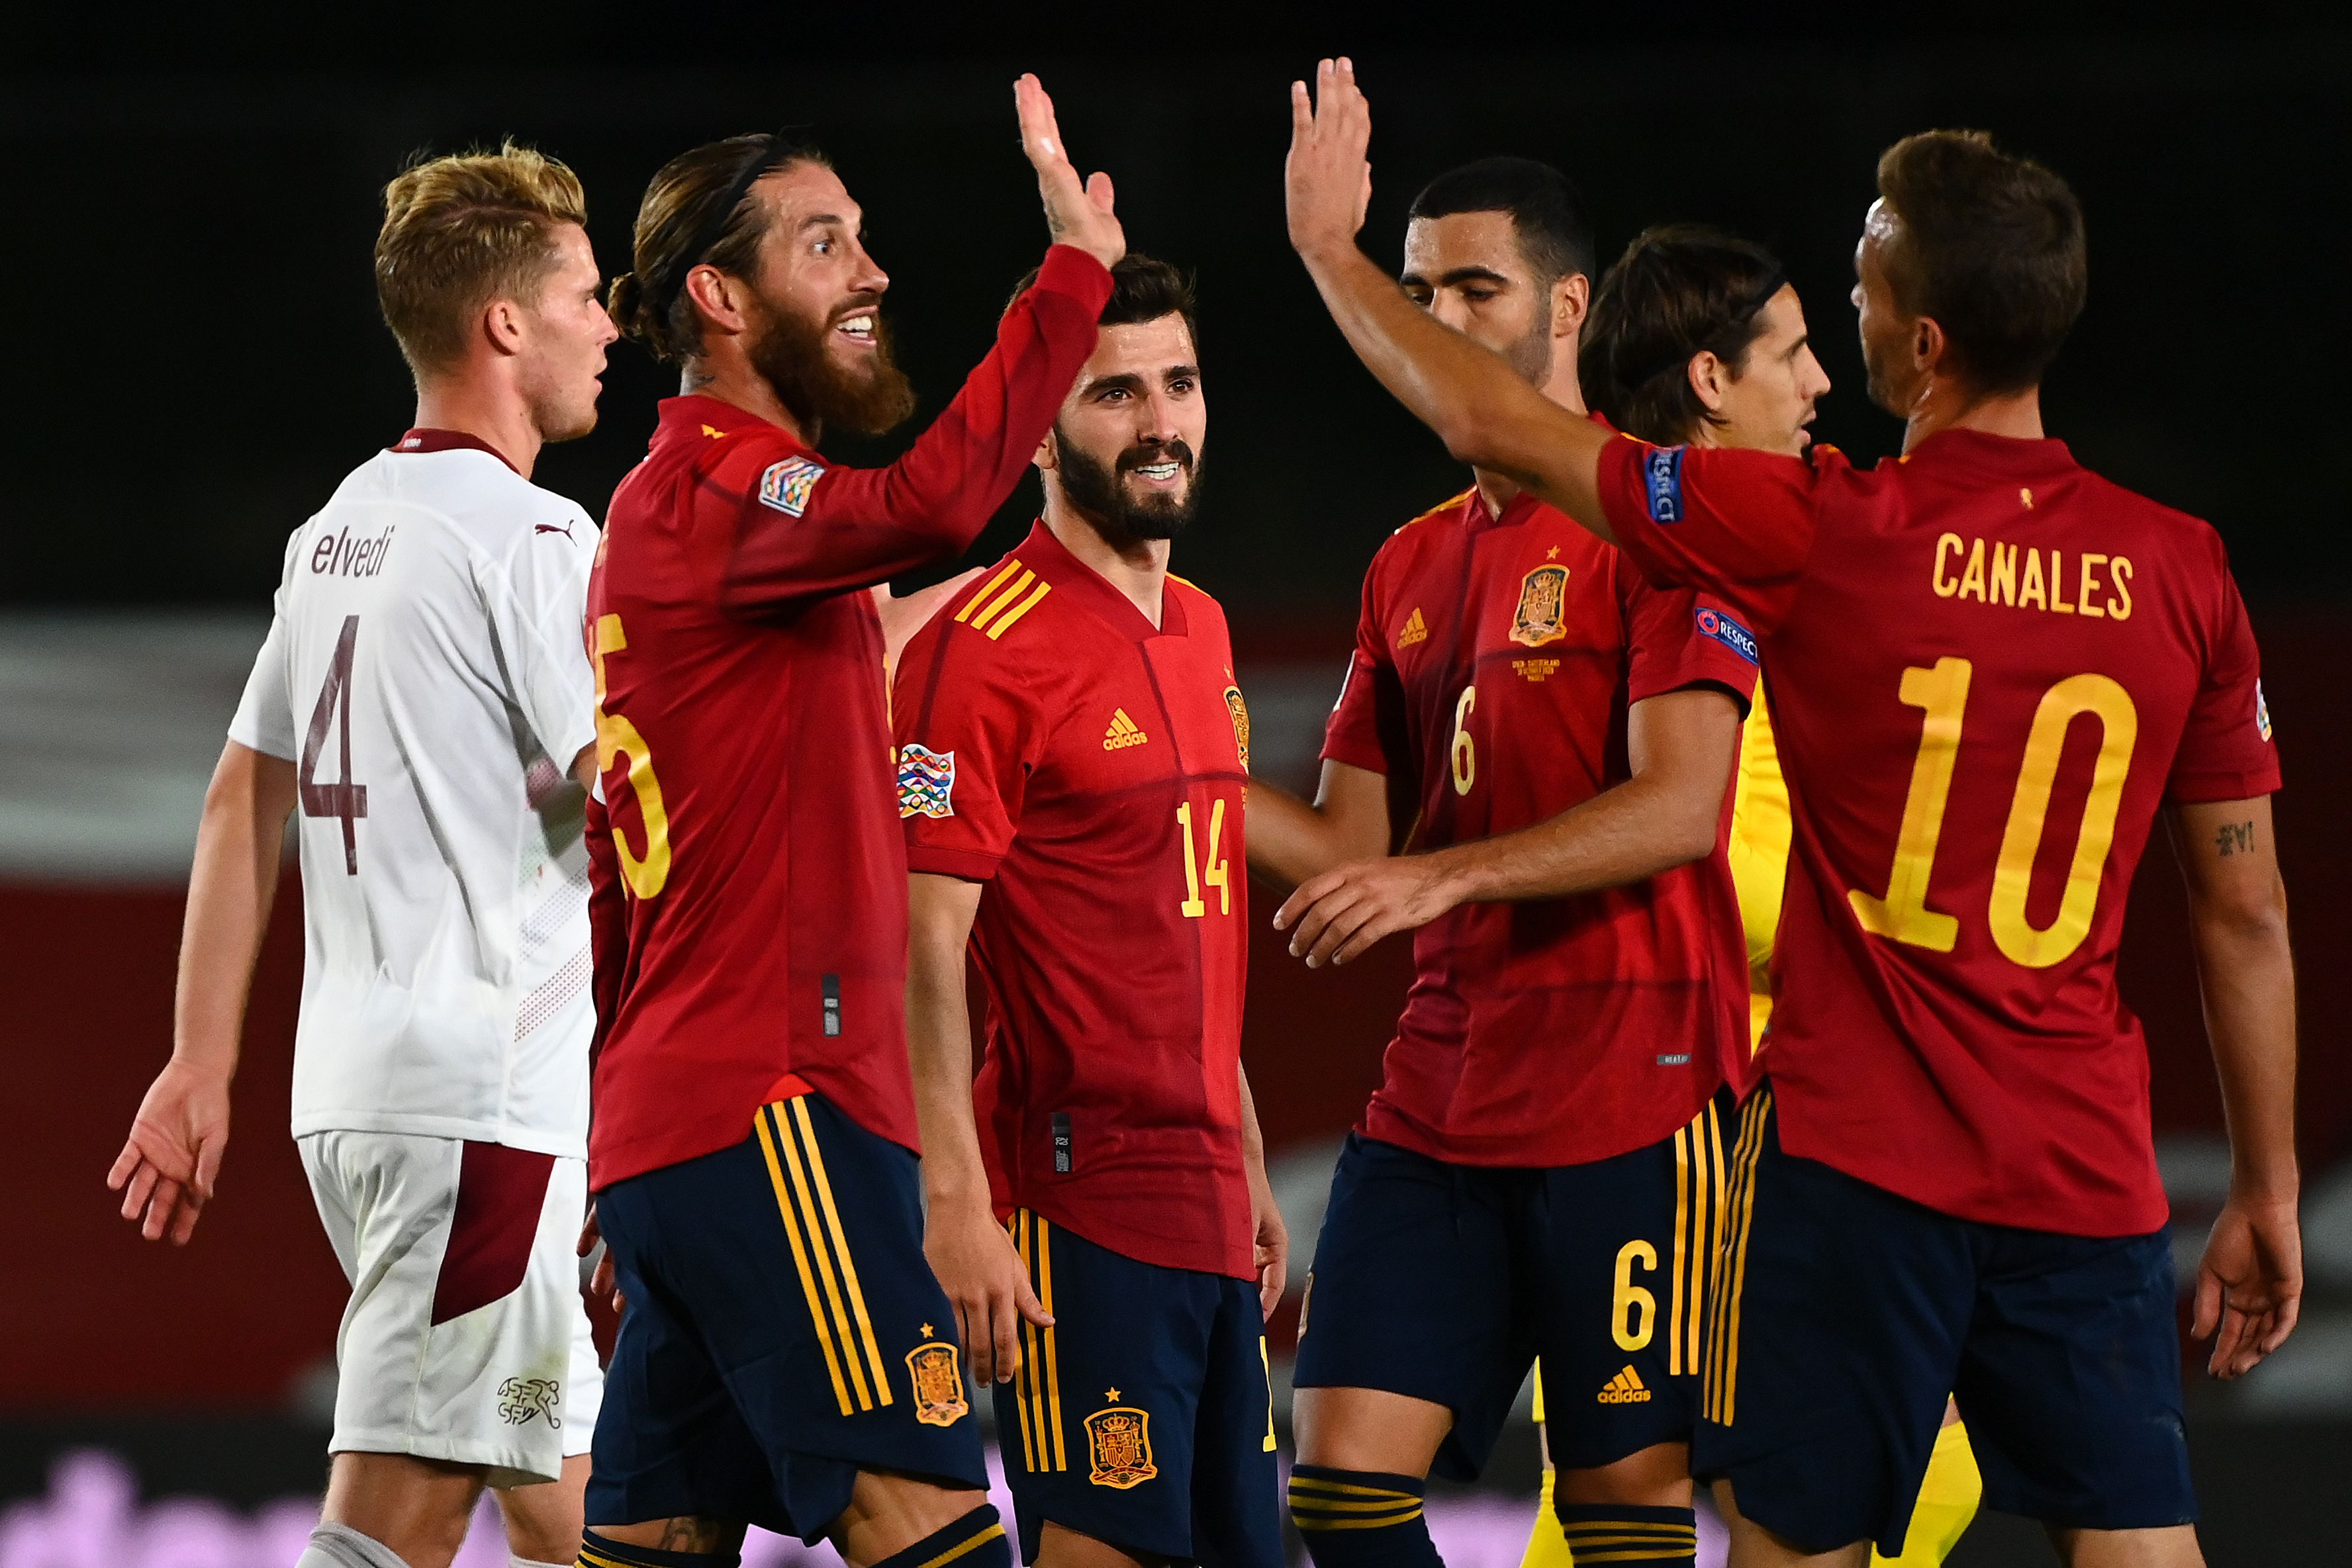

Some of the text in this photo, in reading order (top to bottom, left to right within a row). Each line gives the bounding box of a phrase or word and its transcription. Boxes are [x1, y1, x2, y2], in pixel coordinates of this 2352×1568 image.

[311, 524, 395, 578] elvedi
[1932, 531, 2133, 621] CANALES
[1720, 621, 1758, 659] RESPECT
[299, 615, 367, 876] 4
[588, 612, 672, 901] 5
[1103, 731, 1148, 751] adidas
[1452, 684, 1476, 796] 6
[1176, 798, 1229, 917] 14
[1847, 656, 2138, 968] 10
[1611, 1239, 1658, 1352] 6
[1597, 1389, 1651, 1404] adidas
